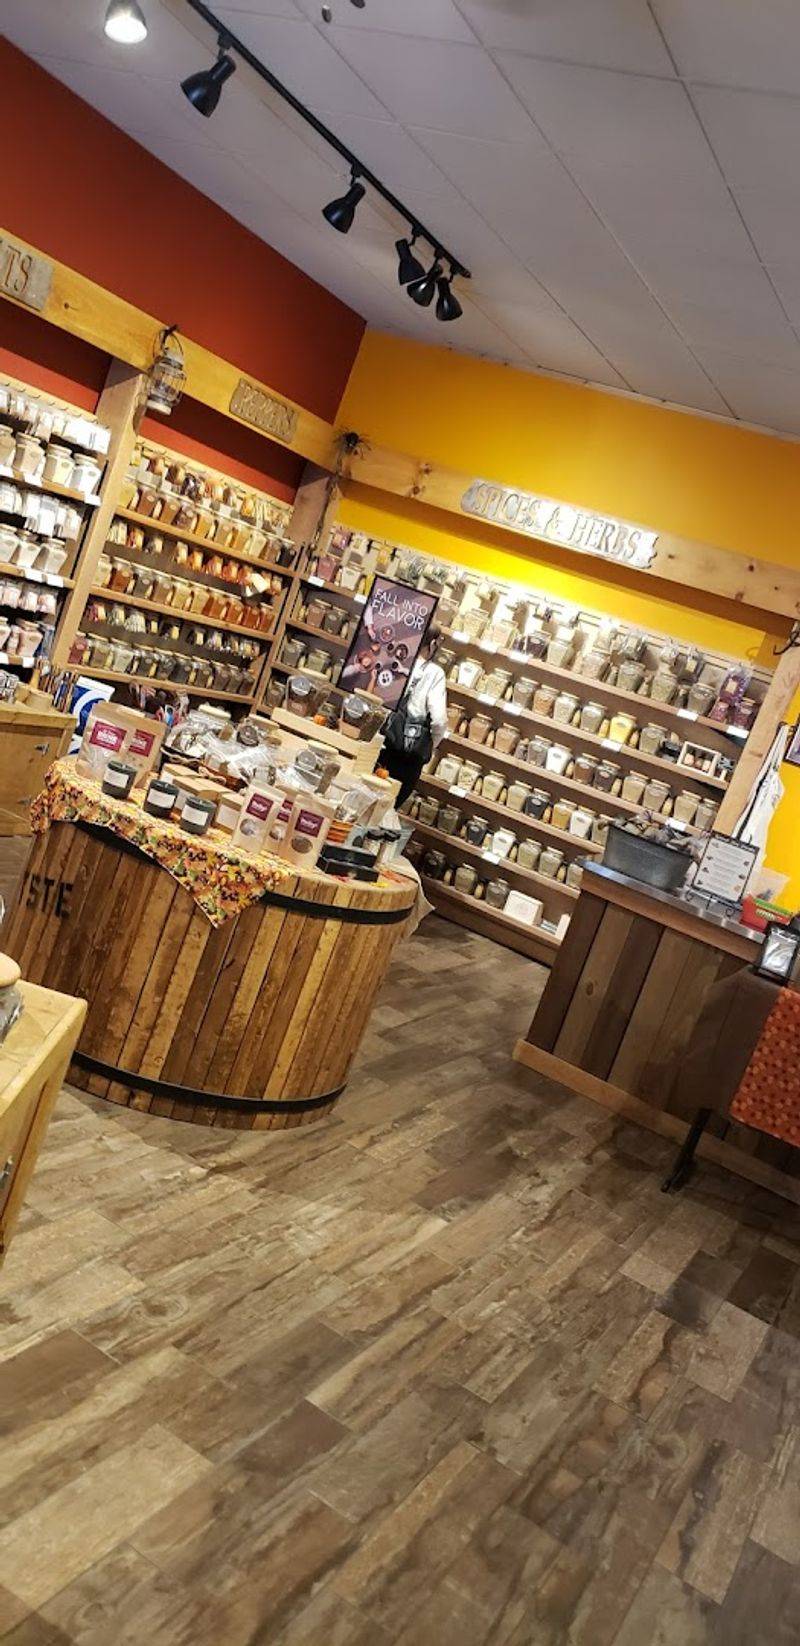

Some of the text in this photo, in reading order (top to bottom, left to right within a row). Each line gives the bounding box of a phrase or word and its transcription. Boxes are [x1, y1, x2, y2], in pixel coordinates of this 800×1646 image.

[0, 237, 34, 293] TS
[475, 483, 642, 560] SPICES & HERBS
[371, 599, 425, 630] FLAVOR
[375, 588, 428, 617] FALL INTO
